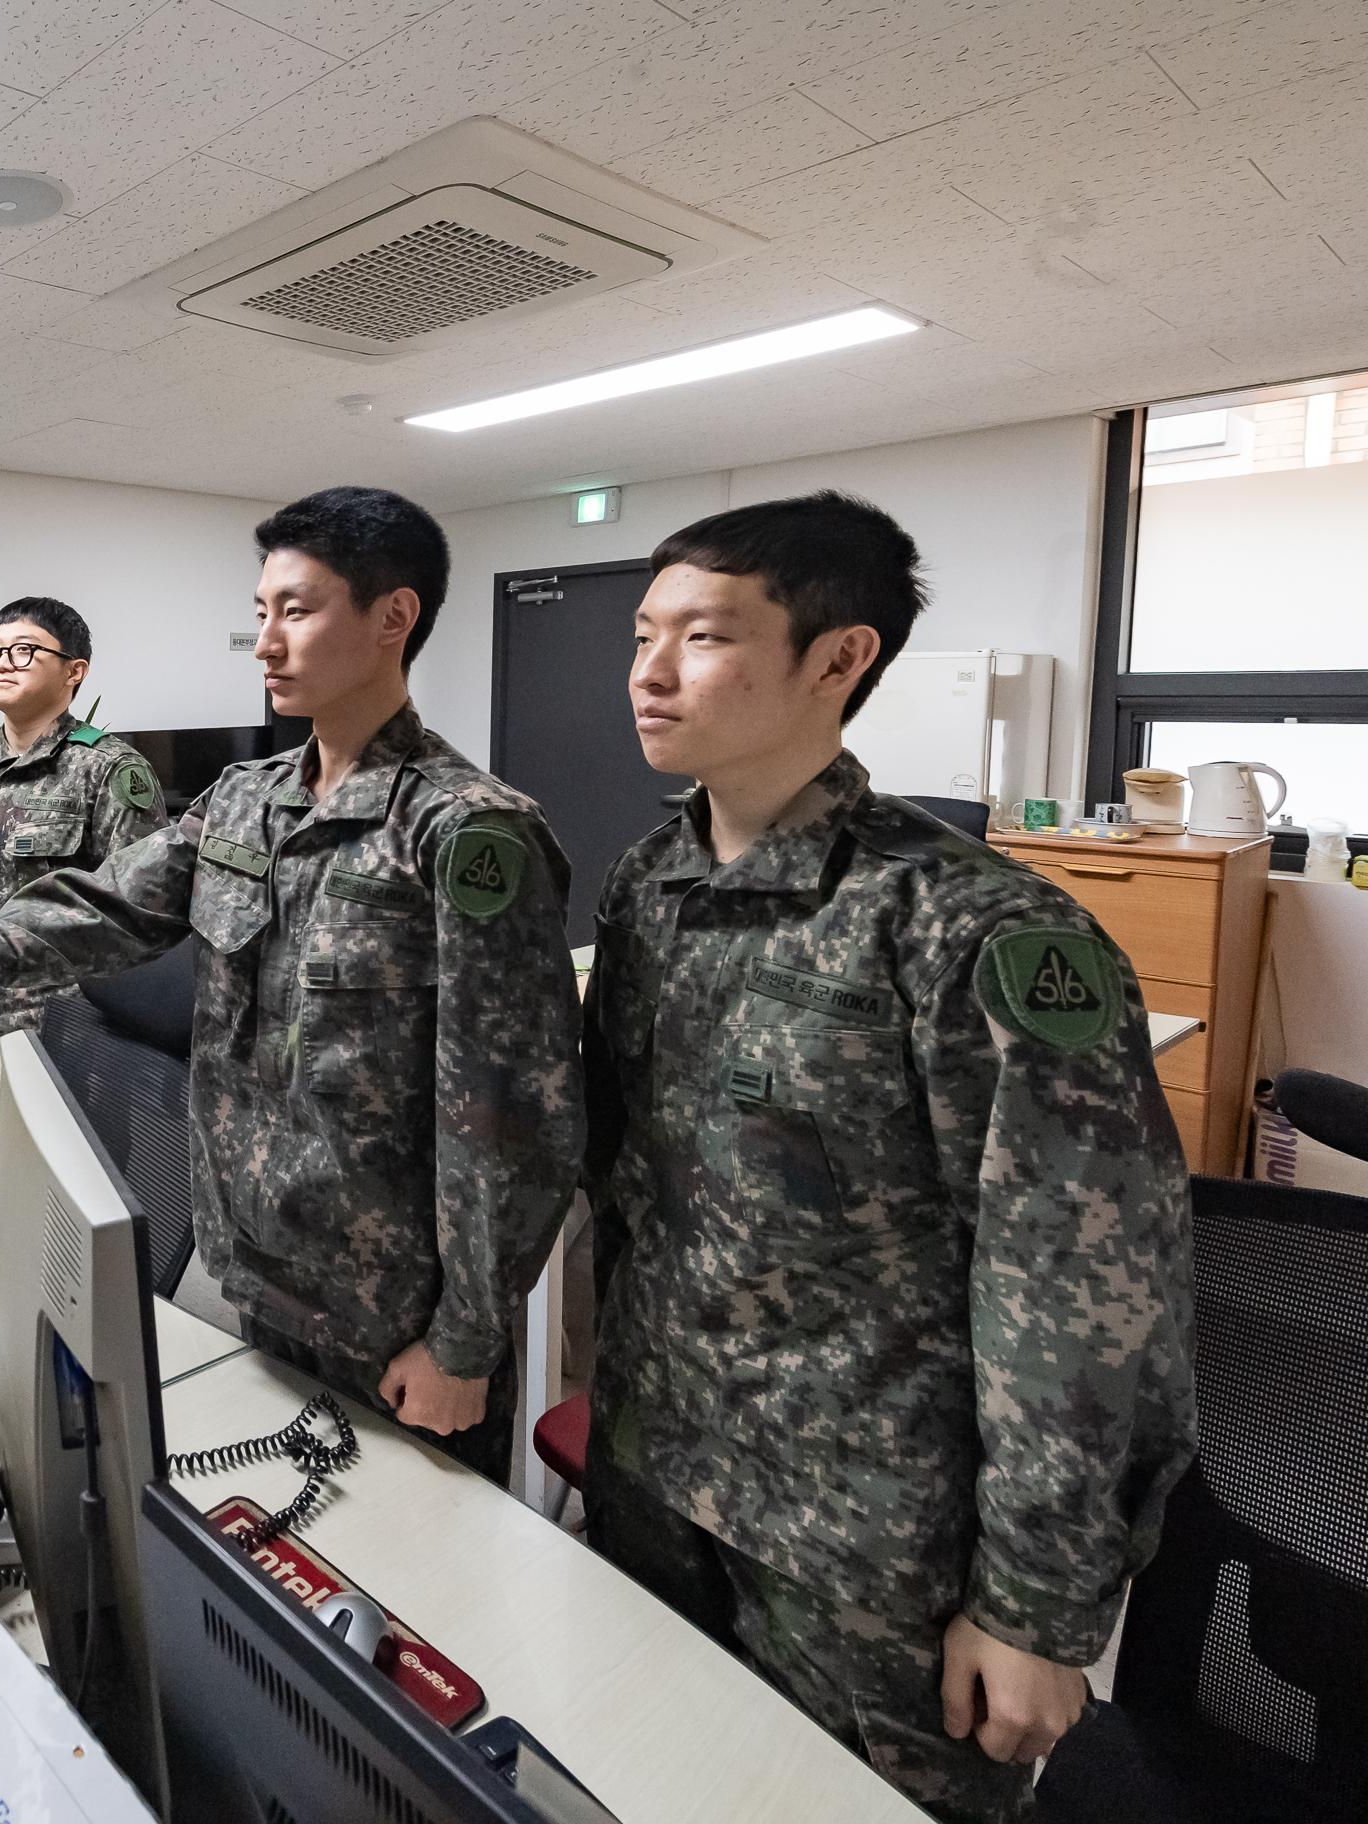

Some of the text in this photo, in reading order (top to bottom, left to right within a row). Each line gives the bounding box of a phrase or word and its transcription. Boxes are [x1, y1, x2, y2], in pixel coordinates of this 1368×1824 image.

[798, 980, 830, 1003] 육군
[831, 988, 879, 1016] ROKA
[1035, 967, 1087, 1003] 56
